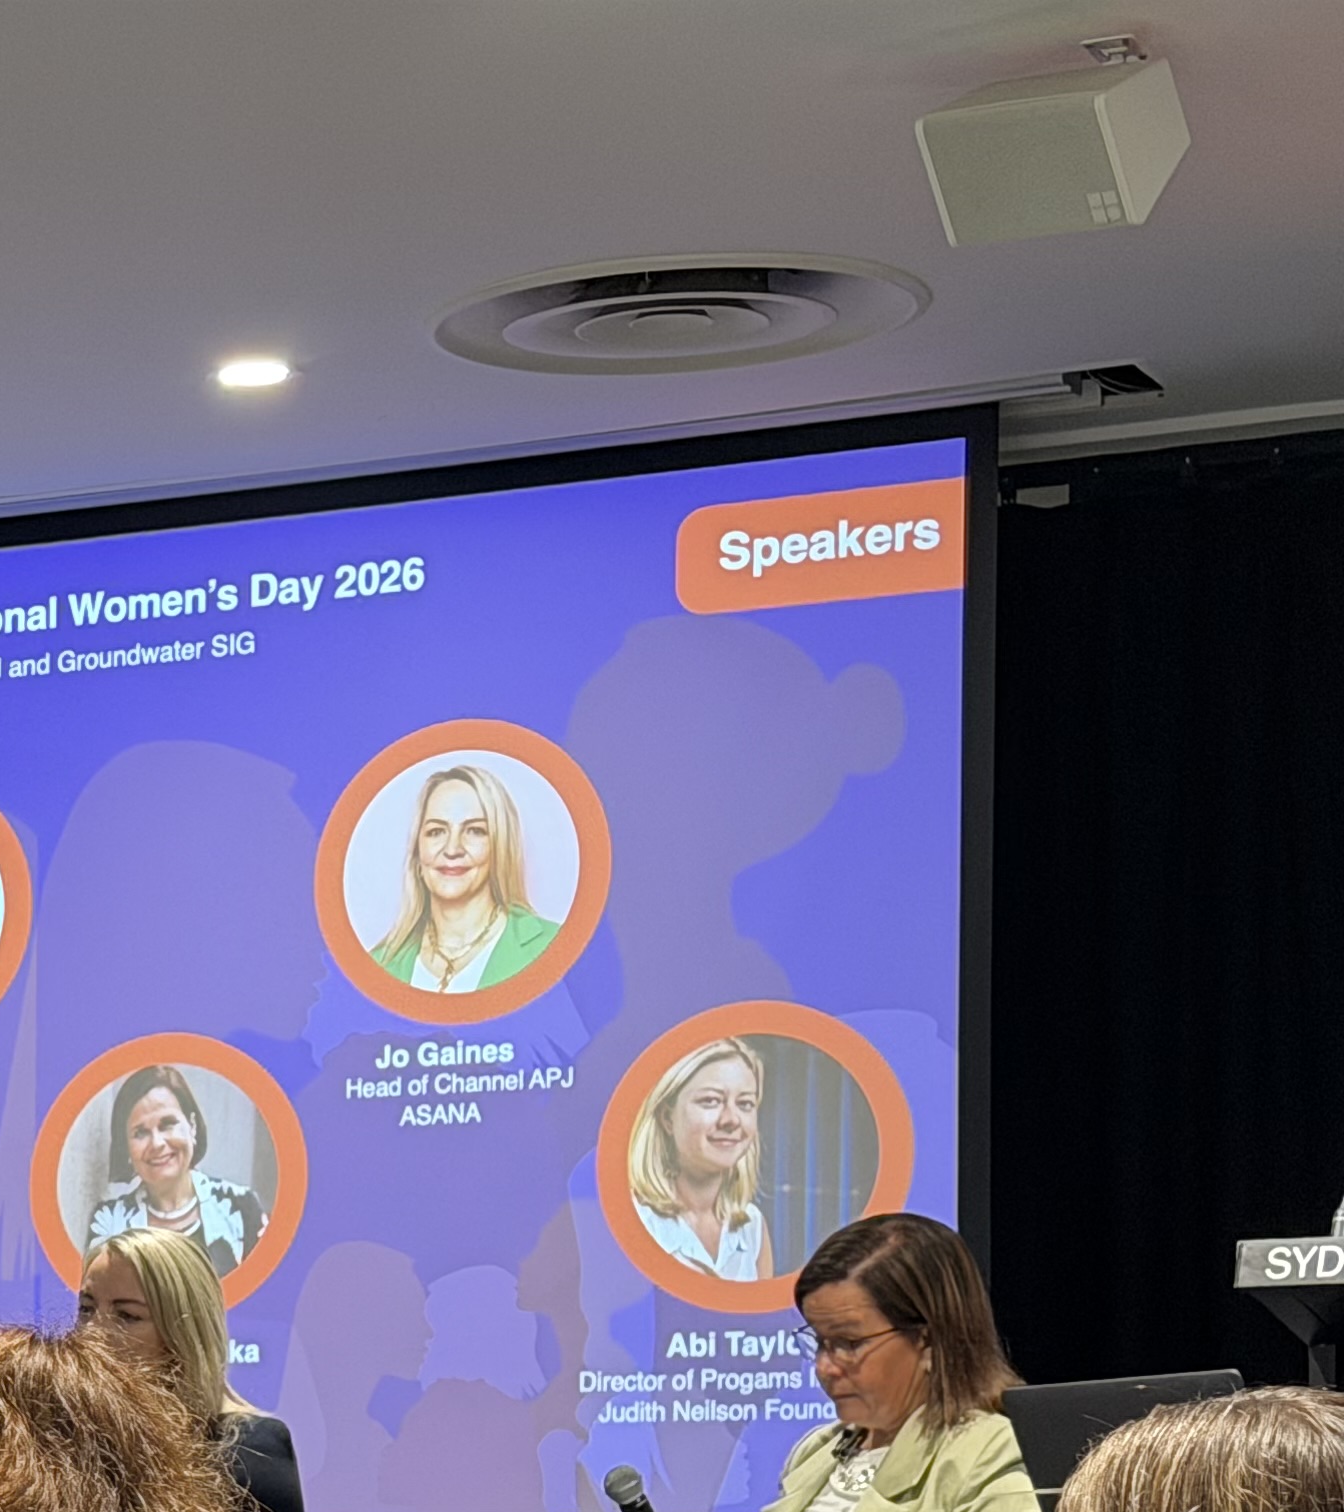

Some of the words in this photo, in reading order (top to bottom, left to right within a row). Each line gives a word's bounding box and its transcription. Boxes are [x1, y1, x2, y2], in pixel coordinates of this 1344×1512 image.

[719, 518, 941, 578] Speakers
[250, 572, 324, 611] Day
[333, 556, 426, 599] 2026
[8, 652, 51, 679] and
[56, 641, 205, 673] Groundwater
[210, 631, 257, 658] SIG
[375, 1044, 410, 1069] Jo
[417, 1040, 515, 1067] Gaines
[345, 1076, 402, 1099] Head
[407, 1073, 429, 1096] of
[434, 1069, 525, 1095] Channel
[528, 1065, 575, 1090] APJ
[398, 1101, 482, 1127] ASANA
[1264, 1245, 1344, 1281] SYD
[666, 1331, 715, 1359] Abi
[724, 1329, 801, 1363] Taylo
[579, 1369, 666, 1393] Director
[671, 1366, 695, 1391] of
[700, 1368, 803, 1396] Progams
[597, 1400, 667, 1424] Judith
[672, 1398, 758, 1422] Neilson
[764, 1397, 838, 1421] Found
